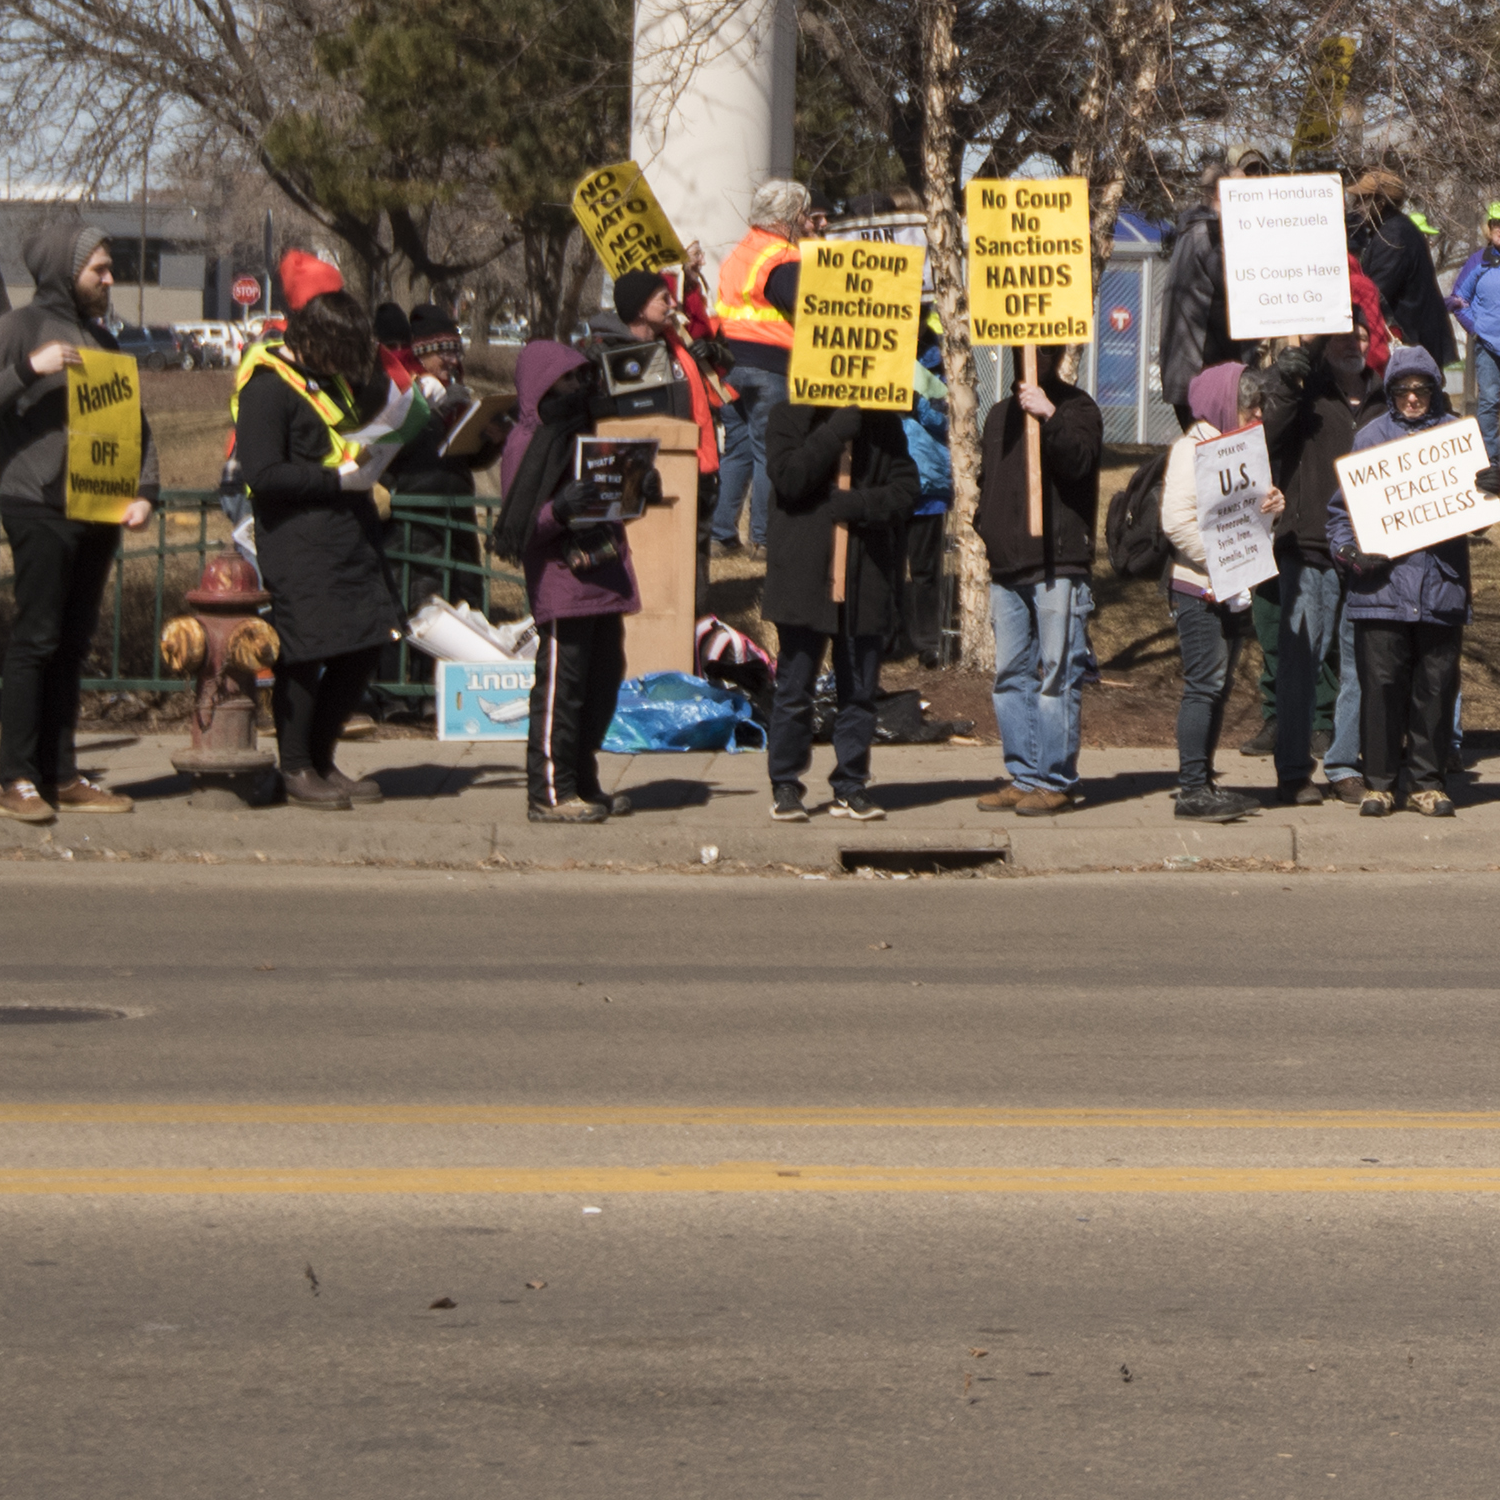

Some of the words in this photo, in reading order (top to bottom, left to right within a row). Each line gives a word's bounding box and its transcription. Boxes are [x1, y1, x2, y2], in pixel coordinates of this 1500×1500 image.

[580, 171, 616, 205] NO
[981, 189, 1007, 209] No
[1015, 188, 1073, 213] Coup
[1228, 190, 1264, 203] From
[1268, 186, 1334, 200] Honduras
[589, 188, 622, 218] TO
[595, 198, 648, 247] NATO
[1011, 212, 1041, 233] No
[1238, 217, 1252, 230] to
[1256, 213, 1328, 228] Venezuela
[609, 222, 645, 257] NO
[975, 235, 1084, 257] Sanctions
[615, 233, 662, 275] NEW
[817, 247, 844, 268] No
[852, 248, 909, 277] Coup
[845, 272, 874, 294] No
[986, 264, 1073, 289] HANDS
[1235, 267, 1256, 282] US
[1260, 266, 1303, 280] Coups
[1307, 264, 1341, 277] Have
[235, 286, 259, 298] STOP
[1005, 292, 1053, 317] OFF
[1258, 293, 1283, 306] Got
[1287, 292, 1299, 304] to
[1303, 290, 1323, 303] Go
[803, 294, 914, 321] Sanctions
[812, 325, 899, 353] HANDS
[974, 316, 1089, 340] Venezuela
[830, 354, 876, 379] OFF
[77, 371, 133, 416] Hands
[794, 377, 908, 403] Venezuela
[92, 440, 119, 466] OFF
[1217, 444, 1235, 459] SPEAK
[1348, 459, 1391, 487] WAR
[1397, 452, 1412, 473] IS
[1418, 433, 1473, 466] COSTLY
[70, 472, 136, 498] Venezuela!
[1219, 462, 1256, 496] U.S.
[1384, 471, 1440, 505] PEACE
[1441, 465, 1459, 487] IS
[1217, 502, 1241, 519] HANDS
[1242, 496, 1257, 510] OFF
[1381, 489, 1476, 535] PRICELESS
[1245, 542, 1259, 556] Iraq
[467, 673, 537, 690] ROUT
